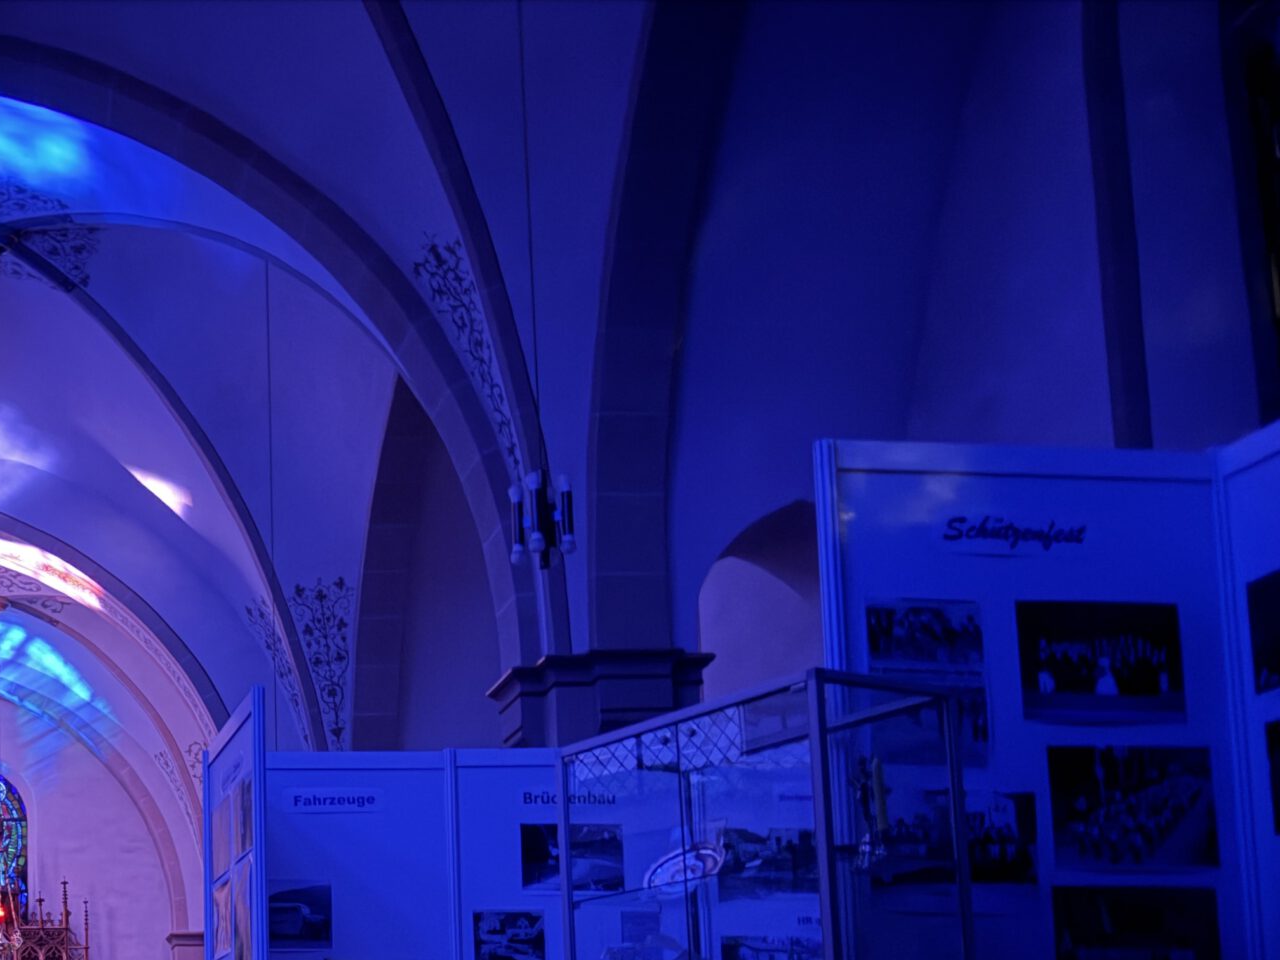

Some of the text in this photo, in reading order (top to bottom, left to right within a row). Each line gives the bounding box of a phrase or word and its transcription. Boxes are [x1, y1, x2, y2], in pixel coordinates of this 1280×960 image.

[943, 515, 1087, 551] Schützenfest
[293, 794, 376, 808] Fahrzeuge
[523, 791, 616, 805] Brücenbau
